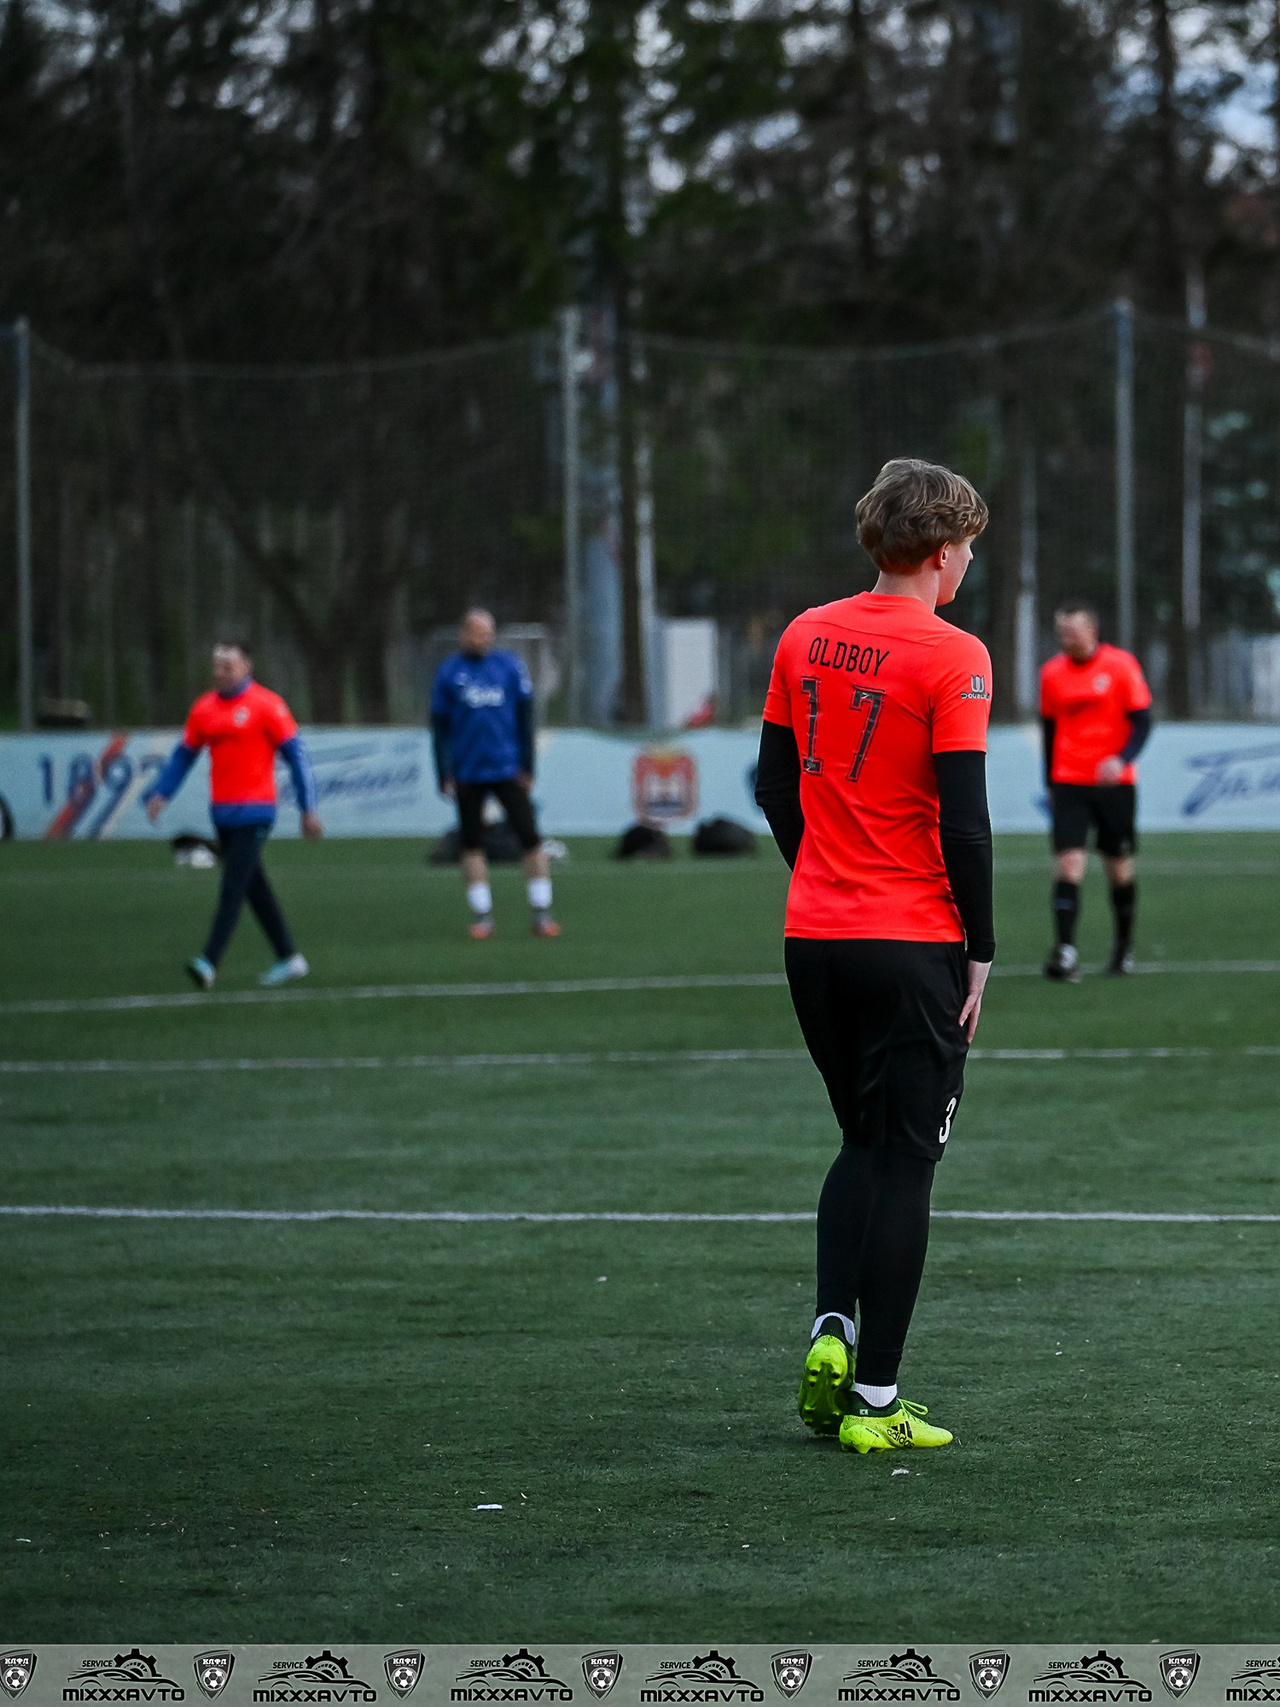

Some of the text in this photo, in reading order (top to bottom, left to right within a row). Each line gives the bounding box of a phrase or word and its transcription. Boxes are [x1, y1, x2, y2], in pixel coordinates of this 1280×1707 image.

[808, 637, 890, 676] OLDBOY
[801, 676, 886, 782] 17
[938, 1096, 957, 1144] 3
[886, 1428, 915, 1449] adidas
